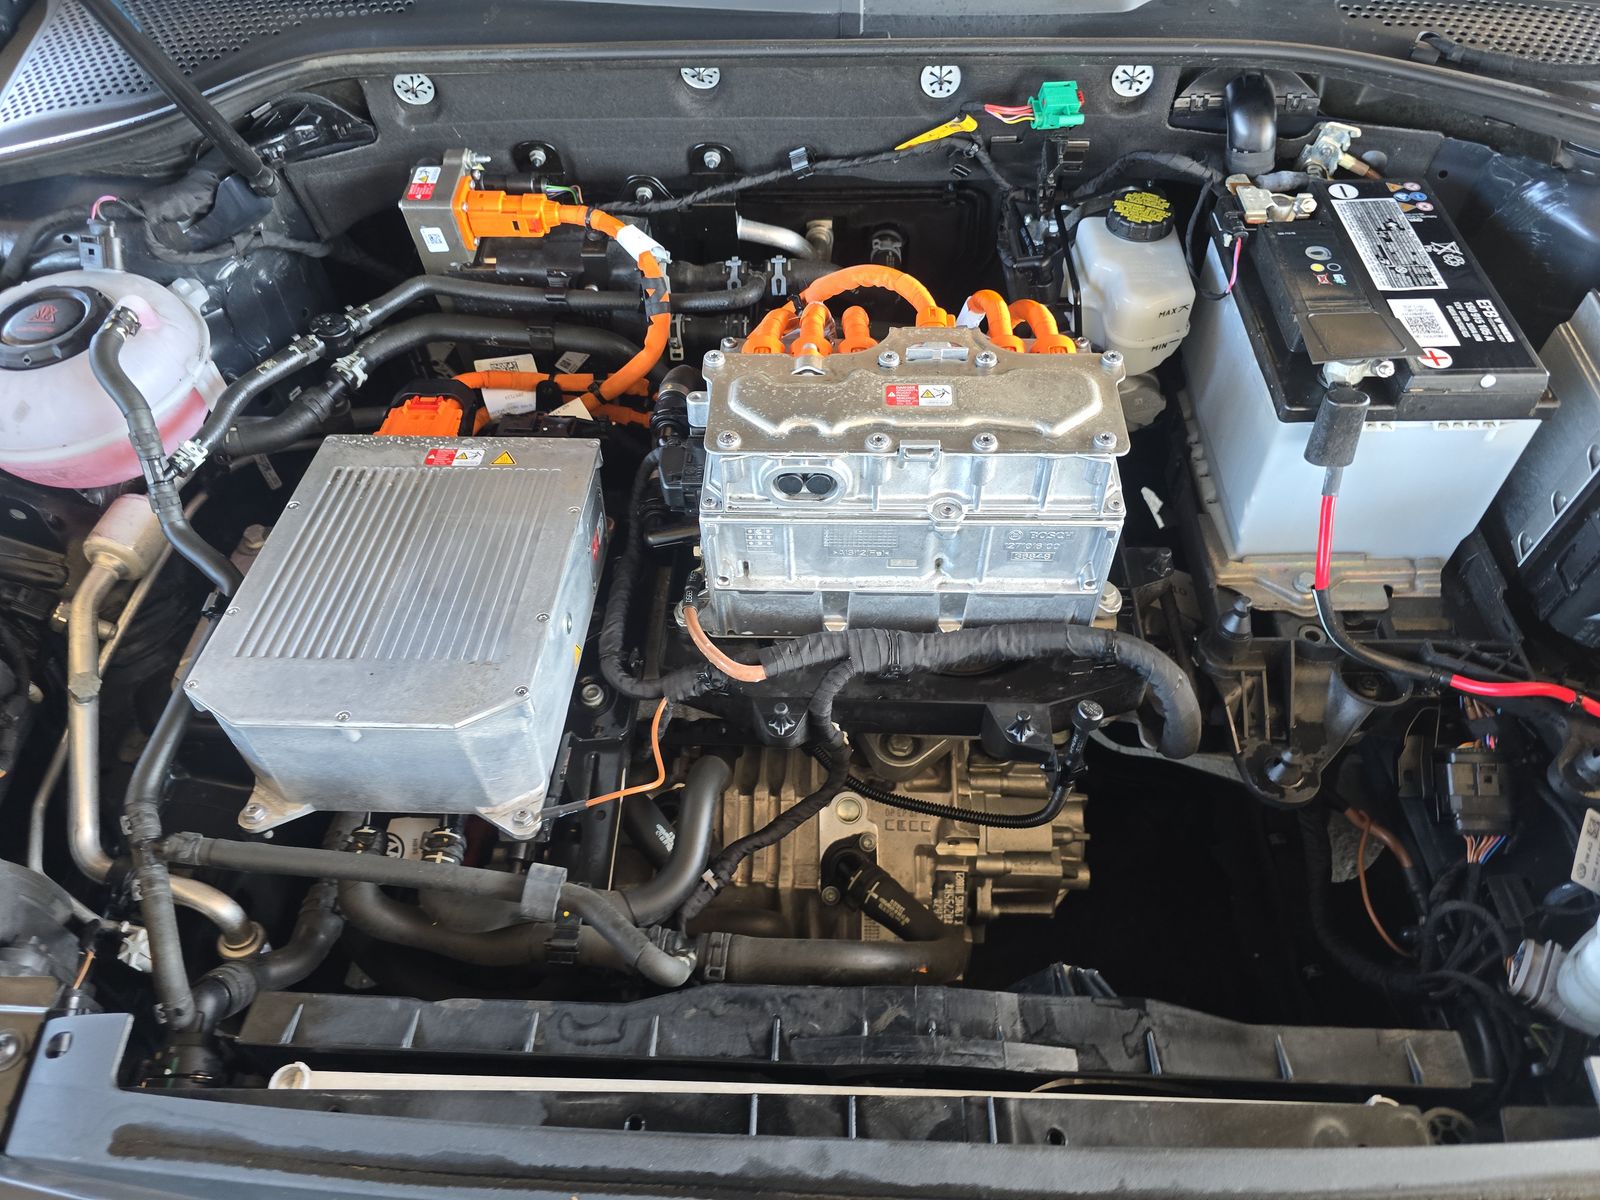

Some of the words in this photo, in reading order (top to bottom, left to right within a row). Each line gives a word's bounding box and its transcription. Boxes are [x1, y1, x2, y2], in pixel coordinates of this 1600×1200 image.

[1158, 307, 1178, 318] MAX
[1476, 299, 1500, 318] EFB
[1151, 342, 1168, 352] MIN
[1030, 531, 1074, 540] BOSCH
